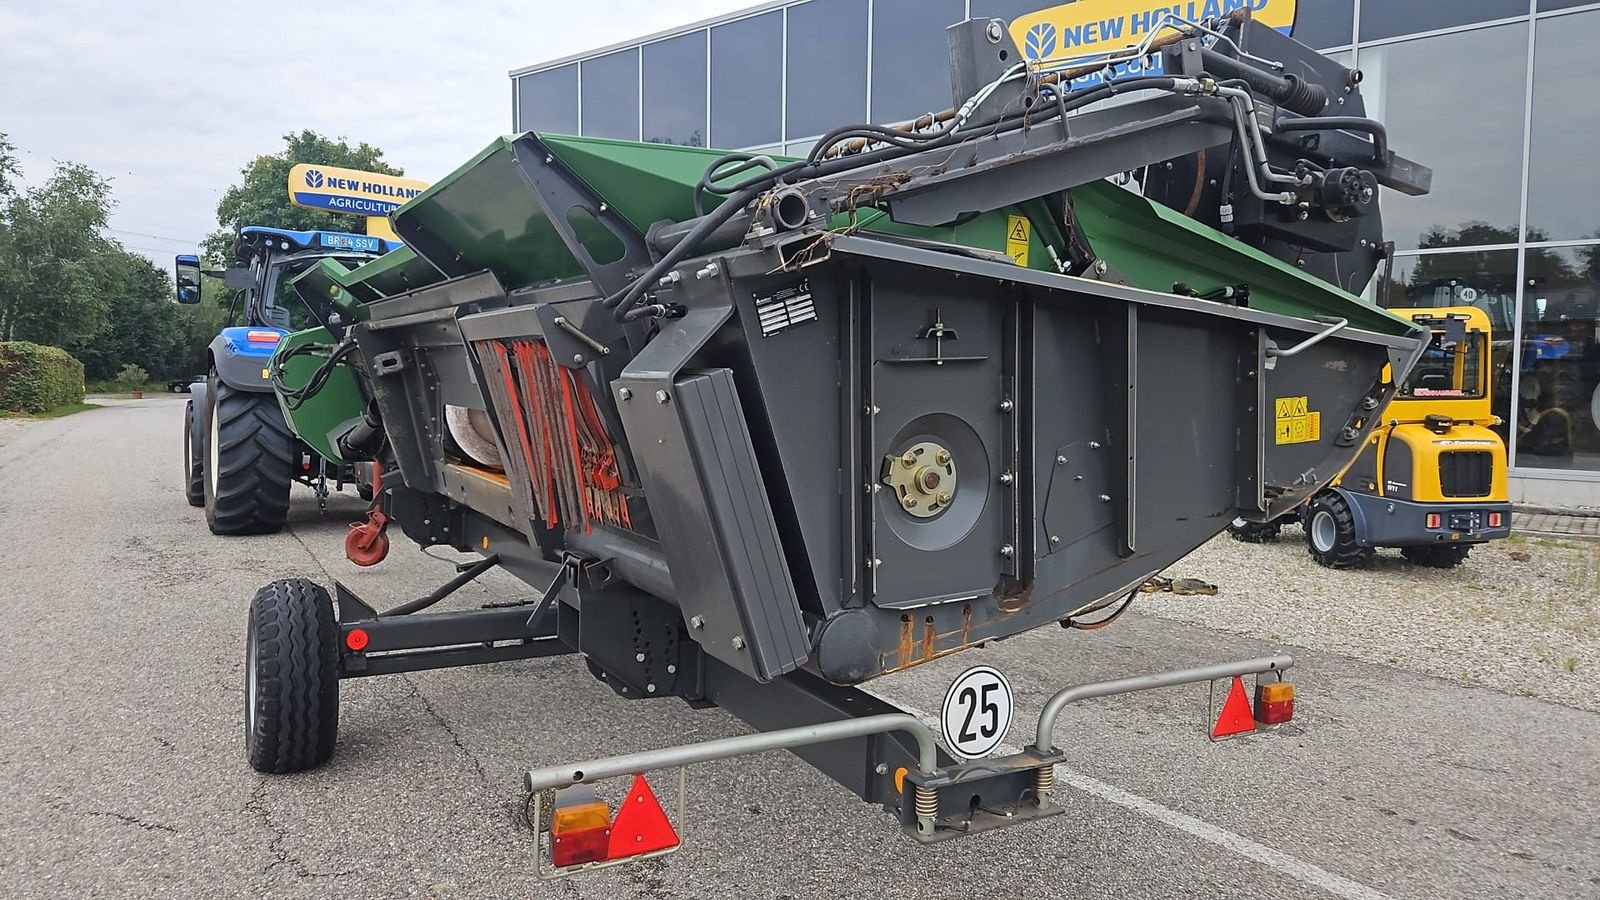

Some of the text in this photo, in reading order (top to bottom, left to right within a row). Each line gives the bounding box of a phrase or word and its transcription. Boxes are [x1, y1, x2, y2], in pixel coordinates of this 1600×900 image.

[1063, 16, 1124, 49] NEW
[327, 177, 359, 191] NEW
[1463, 289, 1474, 299] 40
[958, 682, 999, 744] 25
